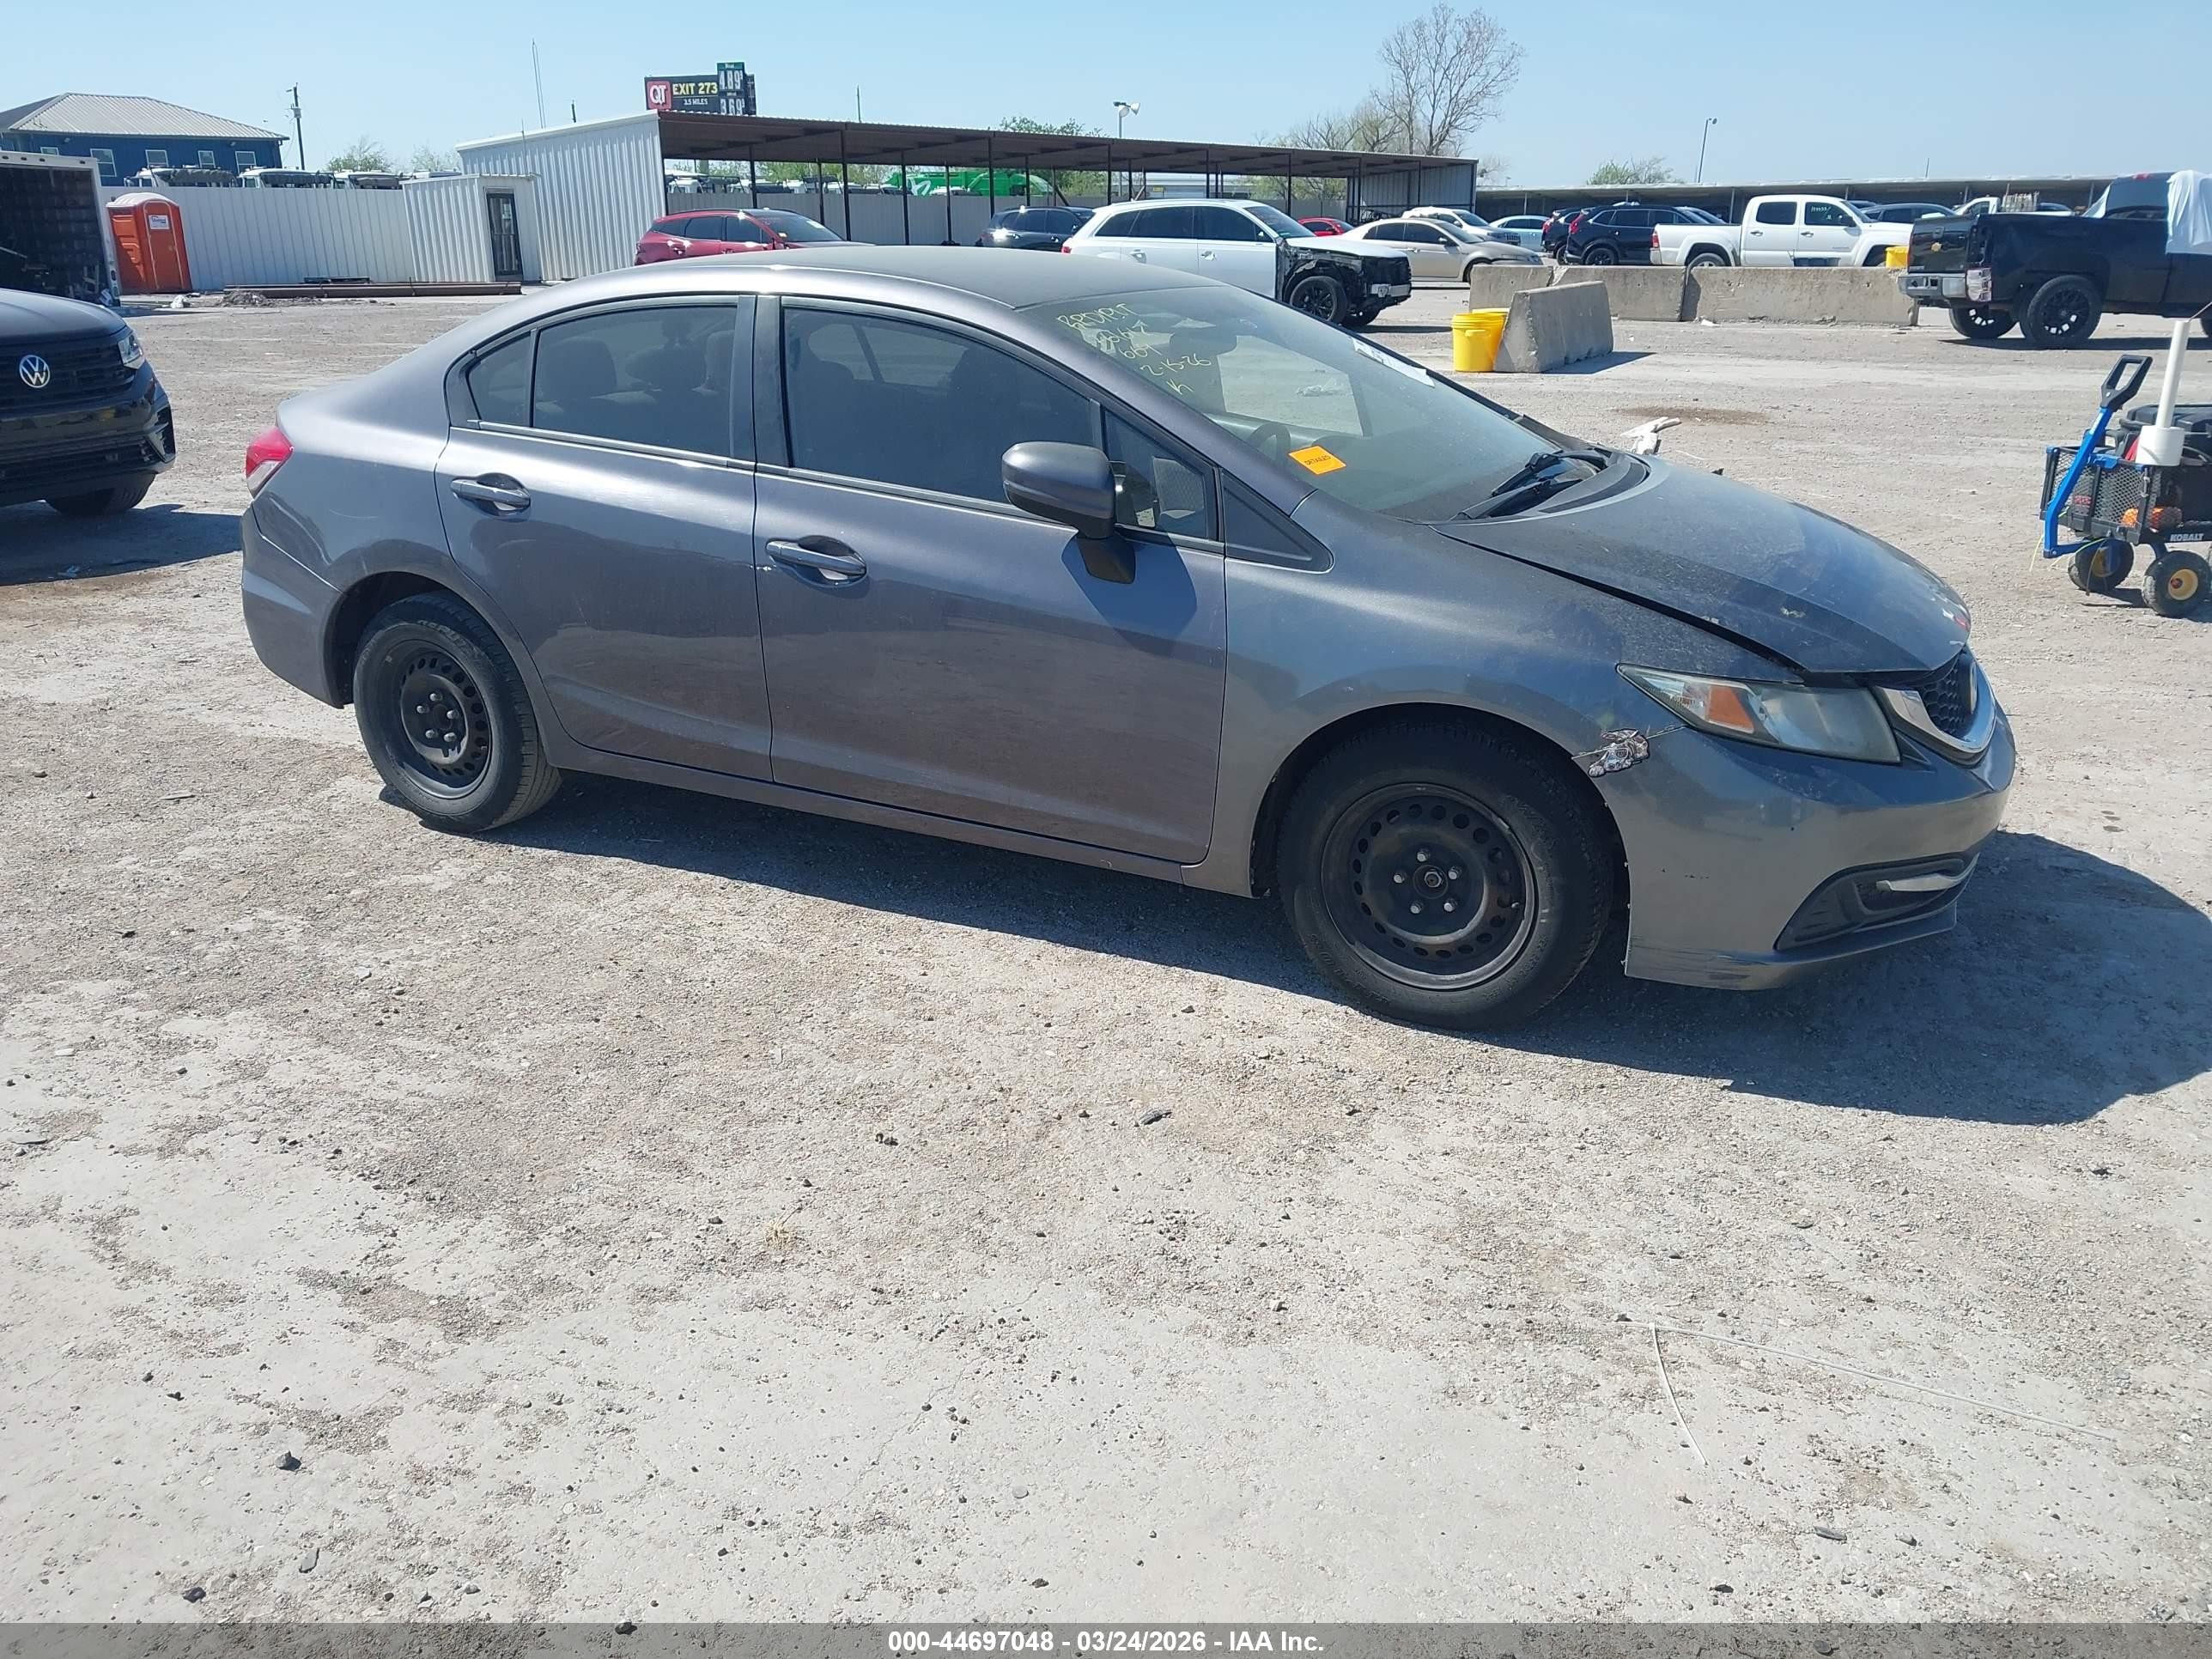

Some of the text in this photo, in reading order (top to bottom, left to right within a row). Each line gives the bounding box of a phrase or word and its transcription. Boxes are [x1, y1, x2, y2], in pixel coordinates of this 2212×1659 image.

[672, 82, 718, 95] EXIT 273
[2170, 533, 2204, 542] KOBALT
